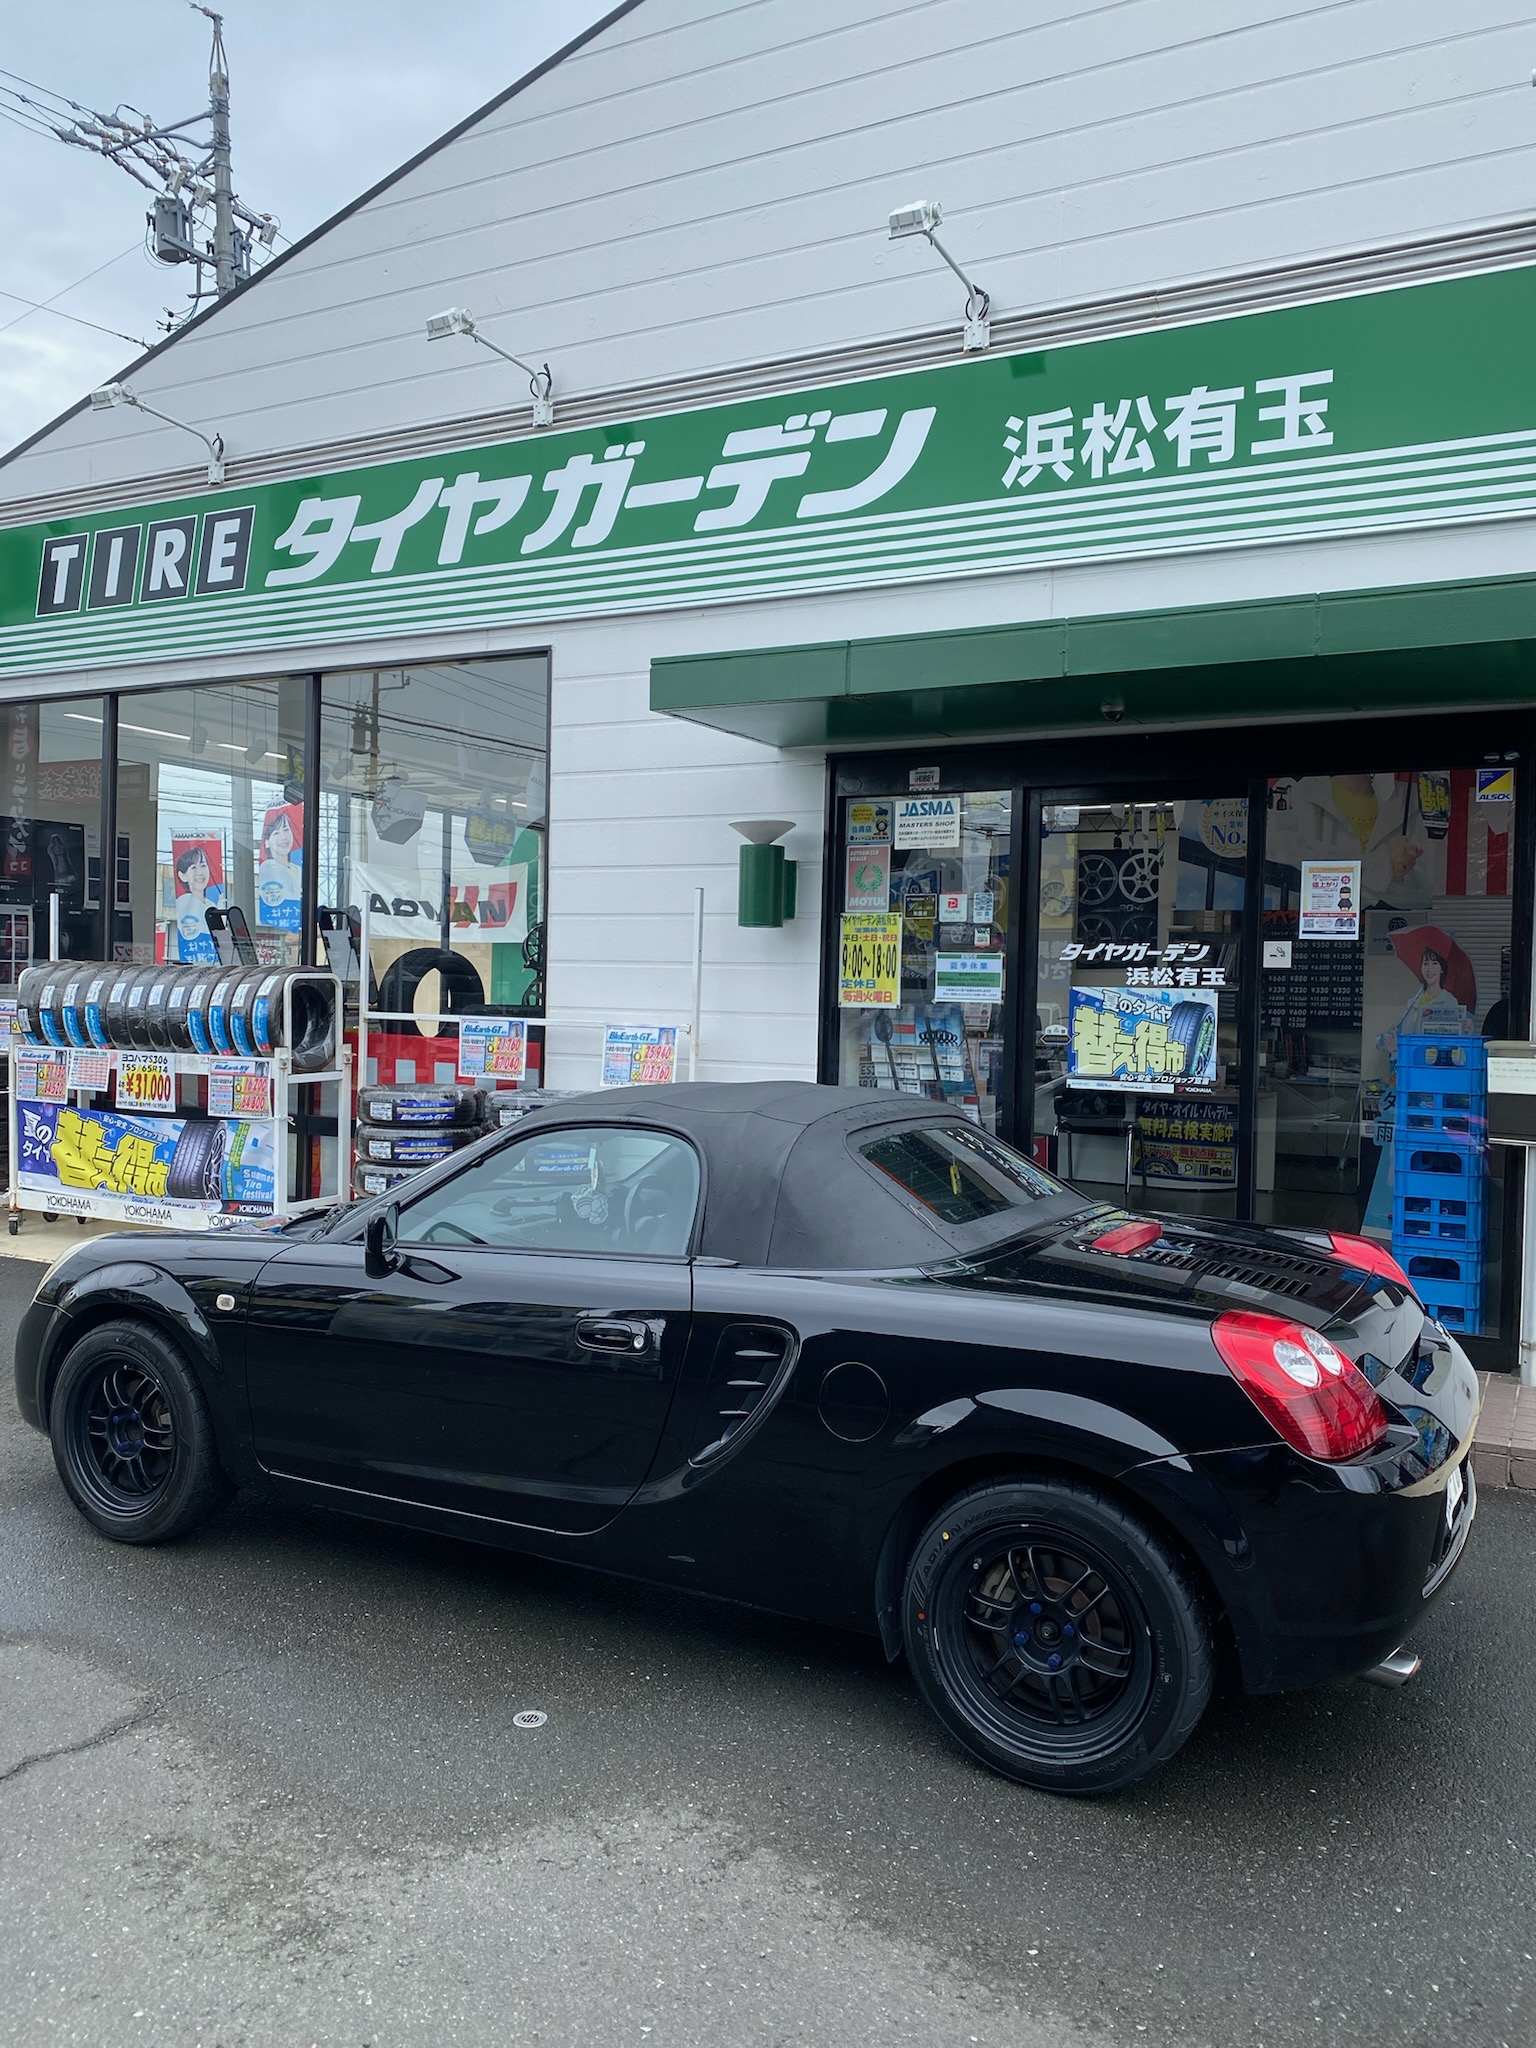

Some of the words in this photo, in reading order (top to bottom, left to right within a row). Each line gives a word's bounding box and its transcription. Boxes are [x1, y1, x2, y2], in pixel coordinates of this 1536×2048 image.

[265, 406, 937, 587] タイヤガーデン
[1001, 368, 1334, 489] 浜松有玉
[48, 515, 243, 606] TIRE
[1479, 793, 1511, 801] ALSOK
[899, 800, 954, 817] JASMA
[851, 825, 872, 834] 会員店
[848, 896, 886, 906] MOTUL
[842, 914, 898, 926] タイヤガーデン浜松有玉
[1059, 942, 1211, 962] タイヤガーデン
[841, 979, 876, 988] 定休日
[1125, 966, 1227, 987] 浜松有玉
[843, 990, 892, 1003] 毎週火曜日
[1102, 989, 1173, 1023] 夏のタイヤ
[464, 1024, 503, 1034] BluEarth-GT
[608, 1031, 652, 1042] BluEarth-GT
[1072, 1005, 1187, 1077] 替え得市
[121, 1053, 169, 1065] ヨコハマS306
[1142, 1100, 1233, 1122] タイヤ・オイル・バッテリー
[22, 1108, 53, 1144] 夏の
[1139, 1116, 1234, 1143] 無料点検実施中
[22, 1140, 51, 1163] タイヤ
[50, 1107, 171, 1197] 替え得市
[398, 1152, 446, 1160] BluEarth-GT
[243, 1168, 274, 1183] Summer
[537, 1164, 587, 1172] BluEarth-GT
[245, 1179, 262, 1189] Tire
[45, 1194, 92, 1211] YOKOHAMA
[238, 1203, 274, 1214] YOKOHAMA
[123, 1204, 173, 1220] YOKOHAMA
